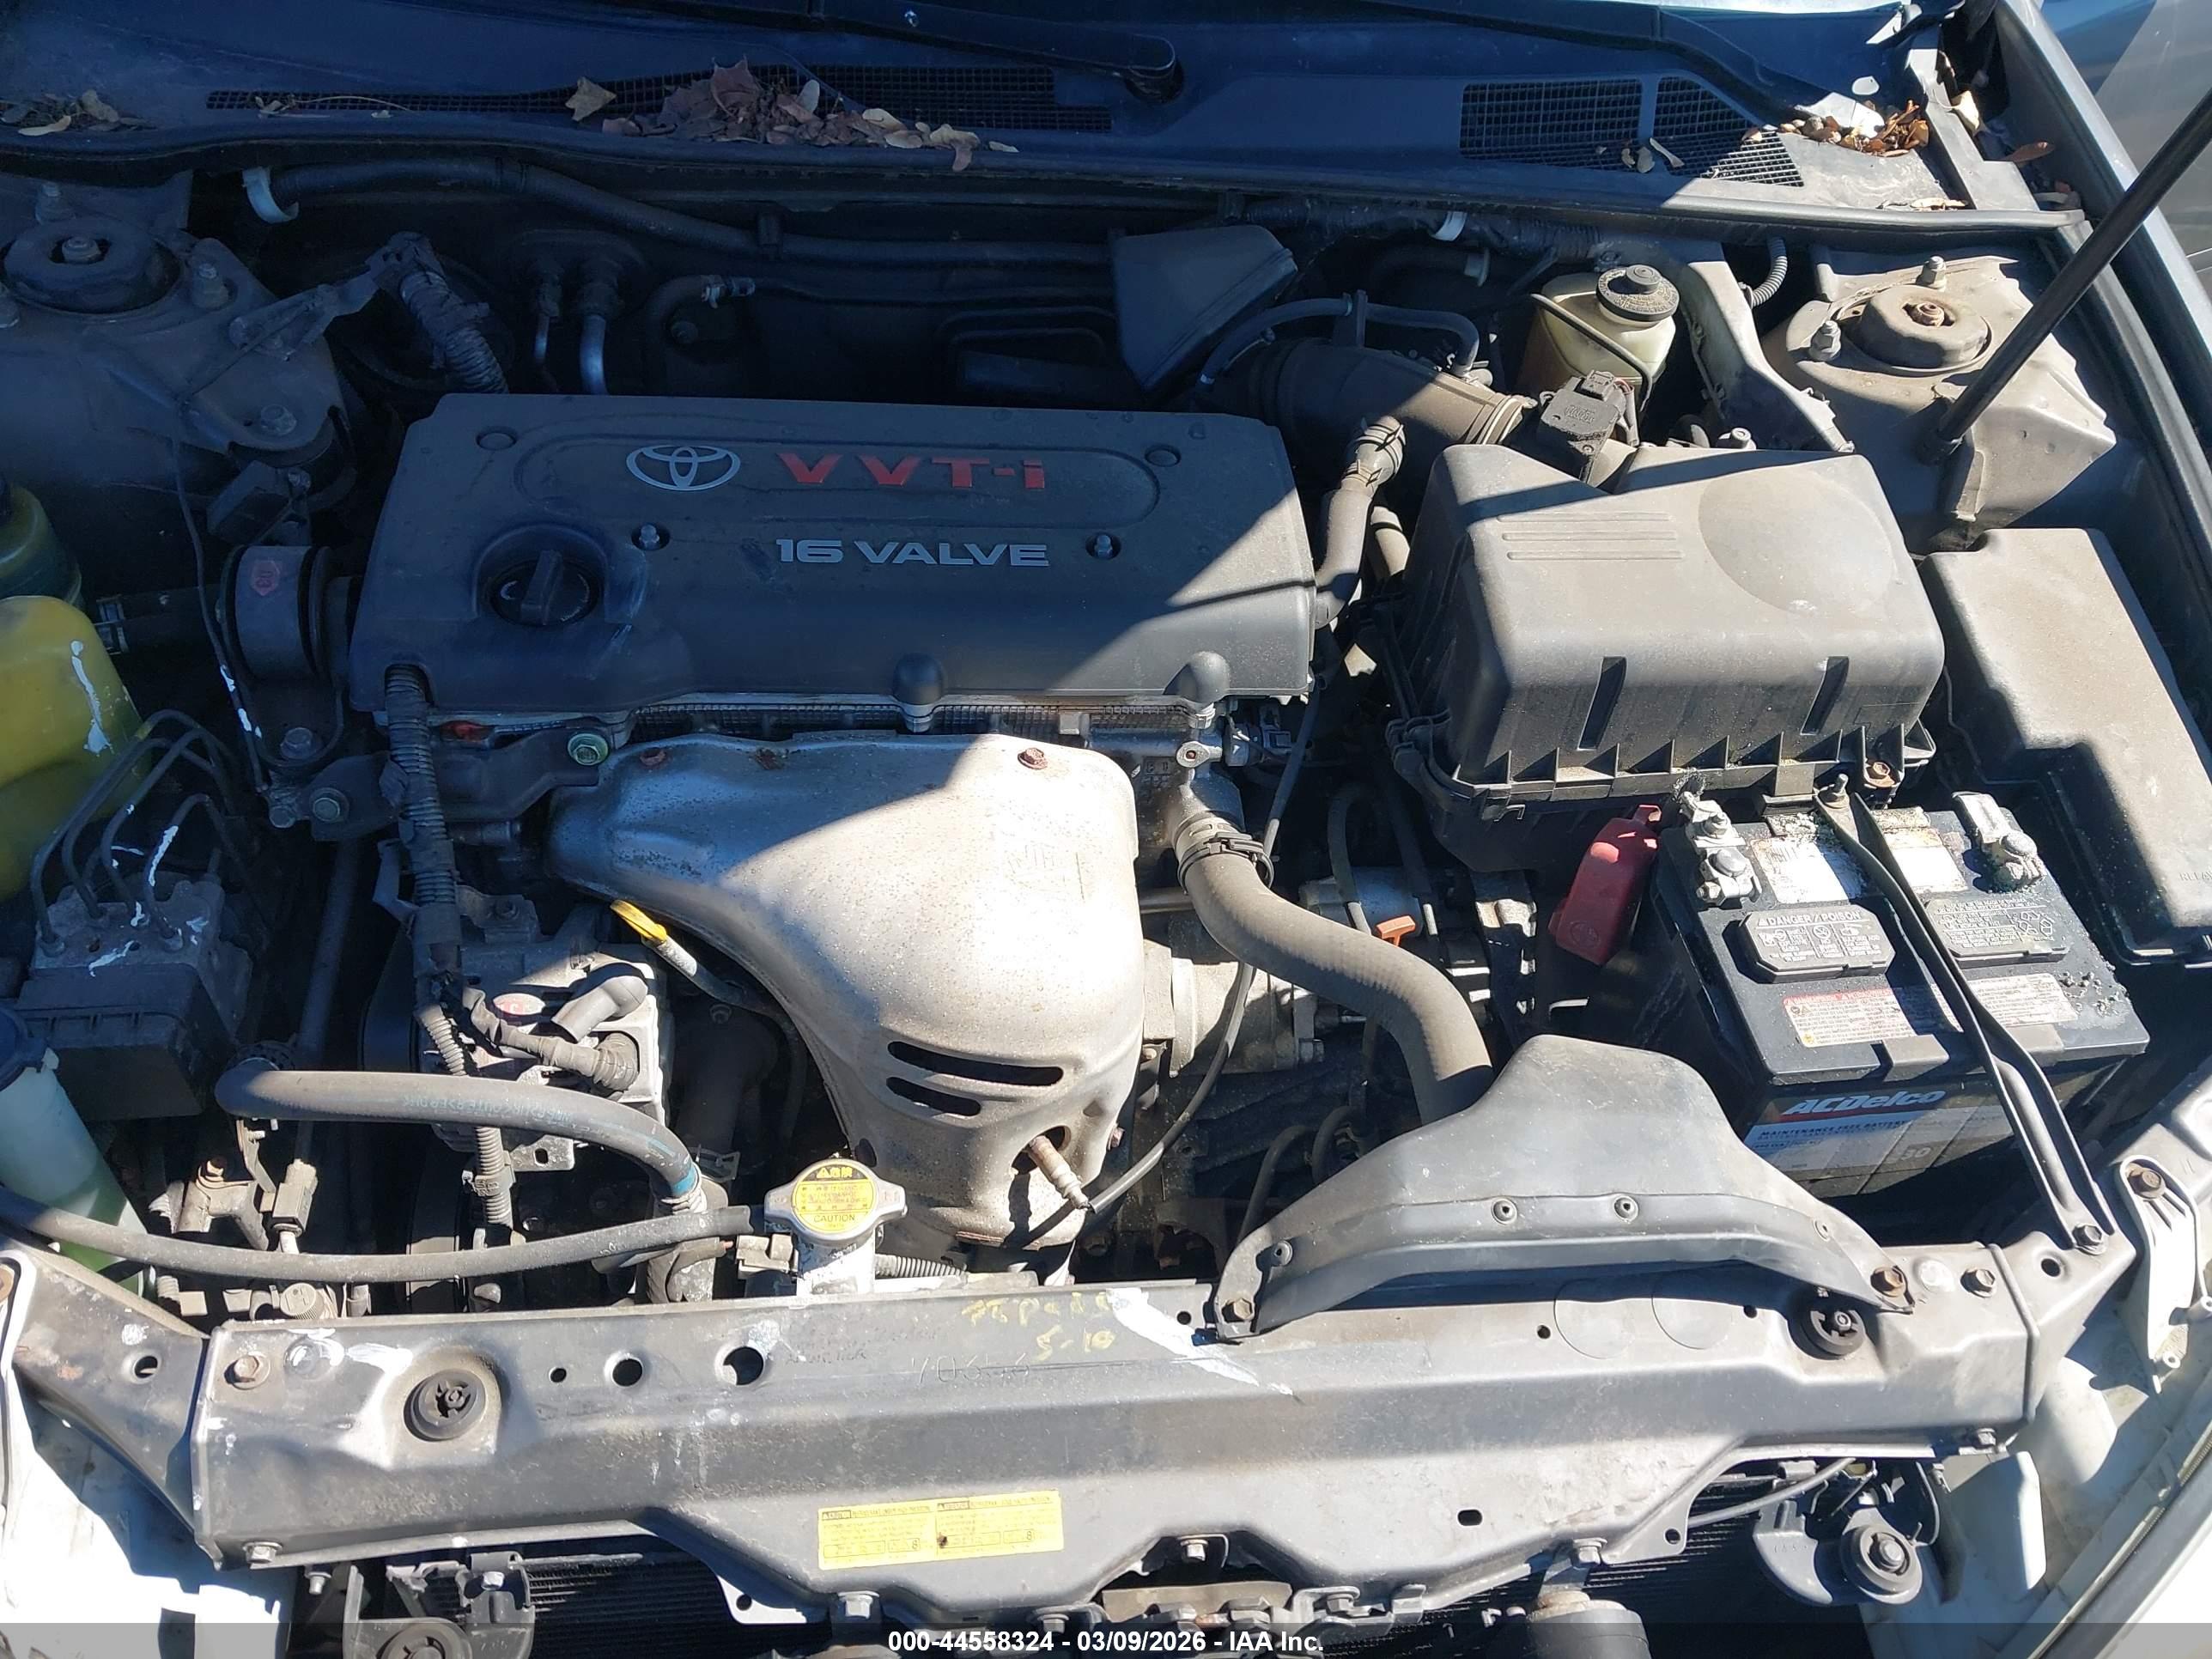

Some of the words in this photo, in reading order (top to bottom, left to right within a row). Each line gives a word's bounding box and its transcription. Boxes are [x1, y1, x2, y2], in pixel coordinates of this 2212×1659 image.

[777, 453, 1045, 489] VVT-i
[775, 538, 843, 562] 16
[854, 540, 1050, 567] VALVE
[1780, 1091, 1948, 1115] ACDelco
[813, 1213, 856, 1224] CAUTION
